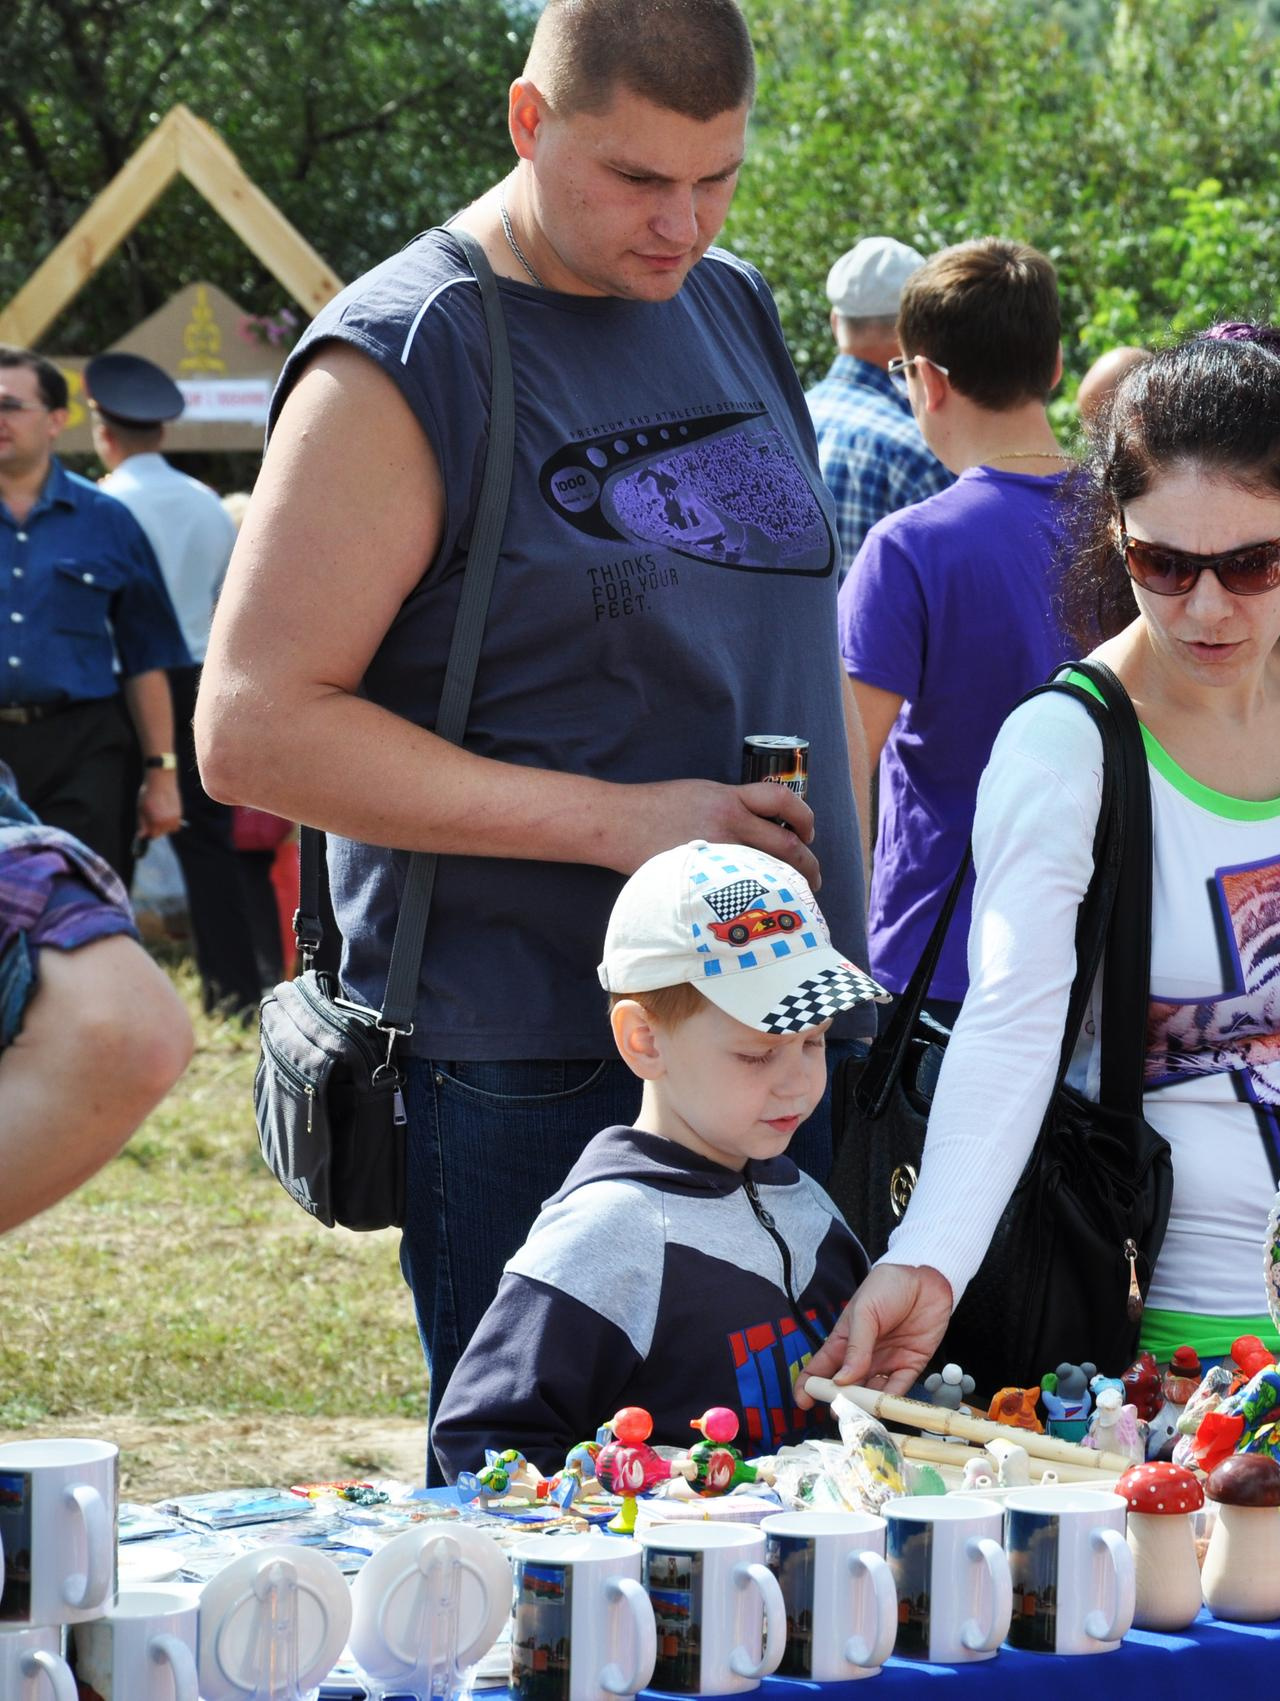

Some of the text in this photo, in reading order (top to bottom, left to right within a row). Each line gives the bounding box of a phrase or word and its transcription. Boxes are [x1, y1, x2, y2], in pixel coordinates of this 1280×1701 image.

[554, 474, 586, 493] 1000
[586, 554, 656, 585] THINKS
[592, 568, 679, 605] FOR YOUR
